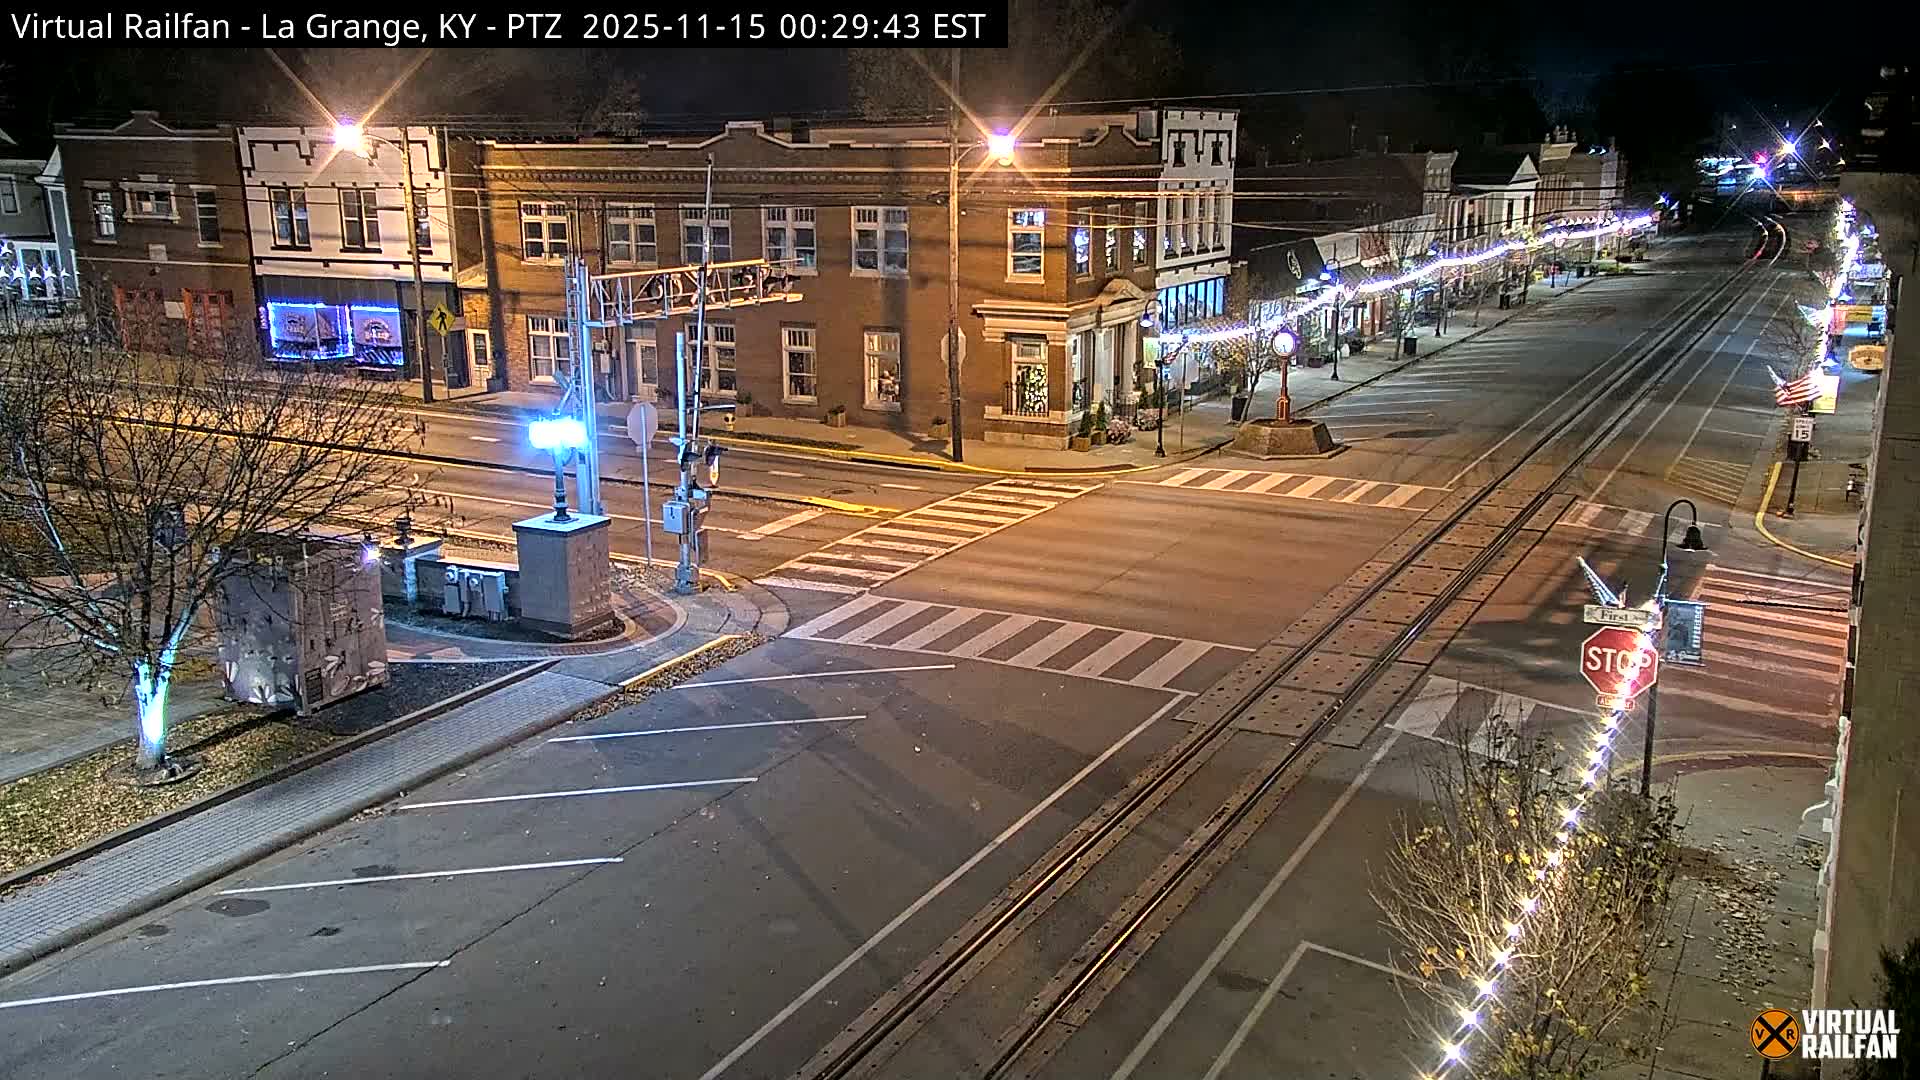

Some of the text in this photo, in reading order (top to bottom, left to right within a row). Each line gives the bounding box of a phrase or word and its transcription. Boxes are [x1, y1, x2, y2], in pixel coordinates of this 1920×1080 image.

[1795, 429, 1810, 440] 15
[1601, 610, 1628, 621] First
[1586, 646, 1652, 676] STOP
